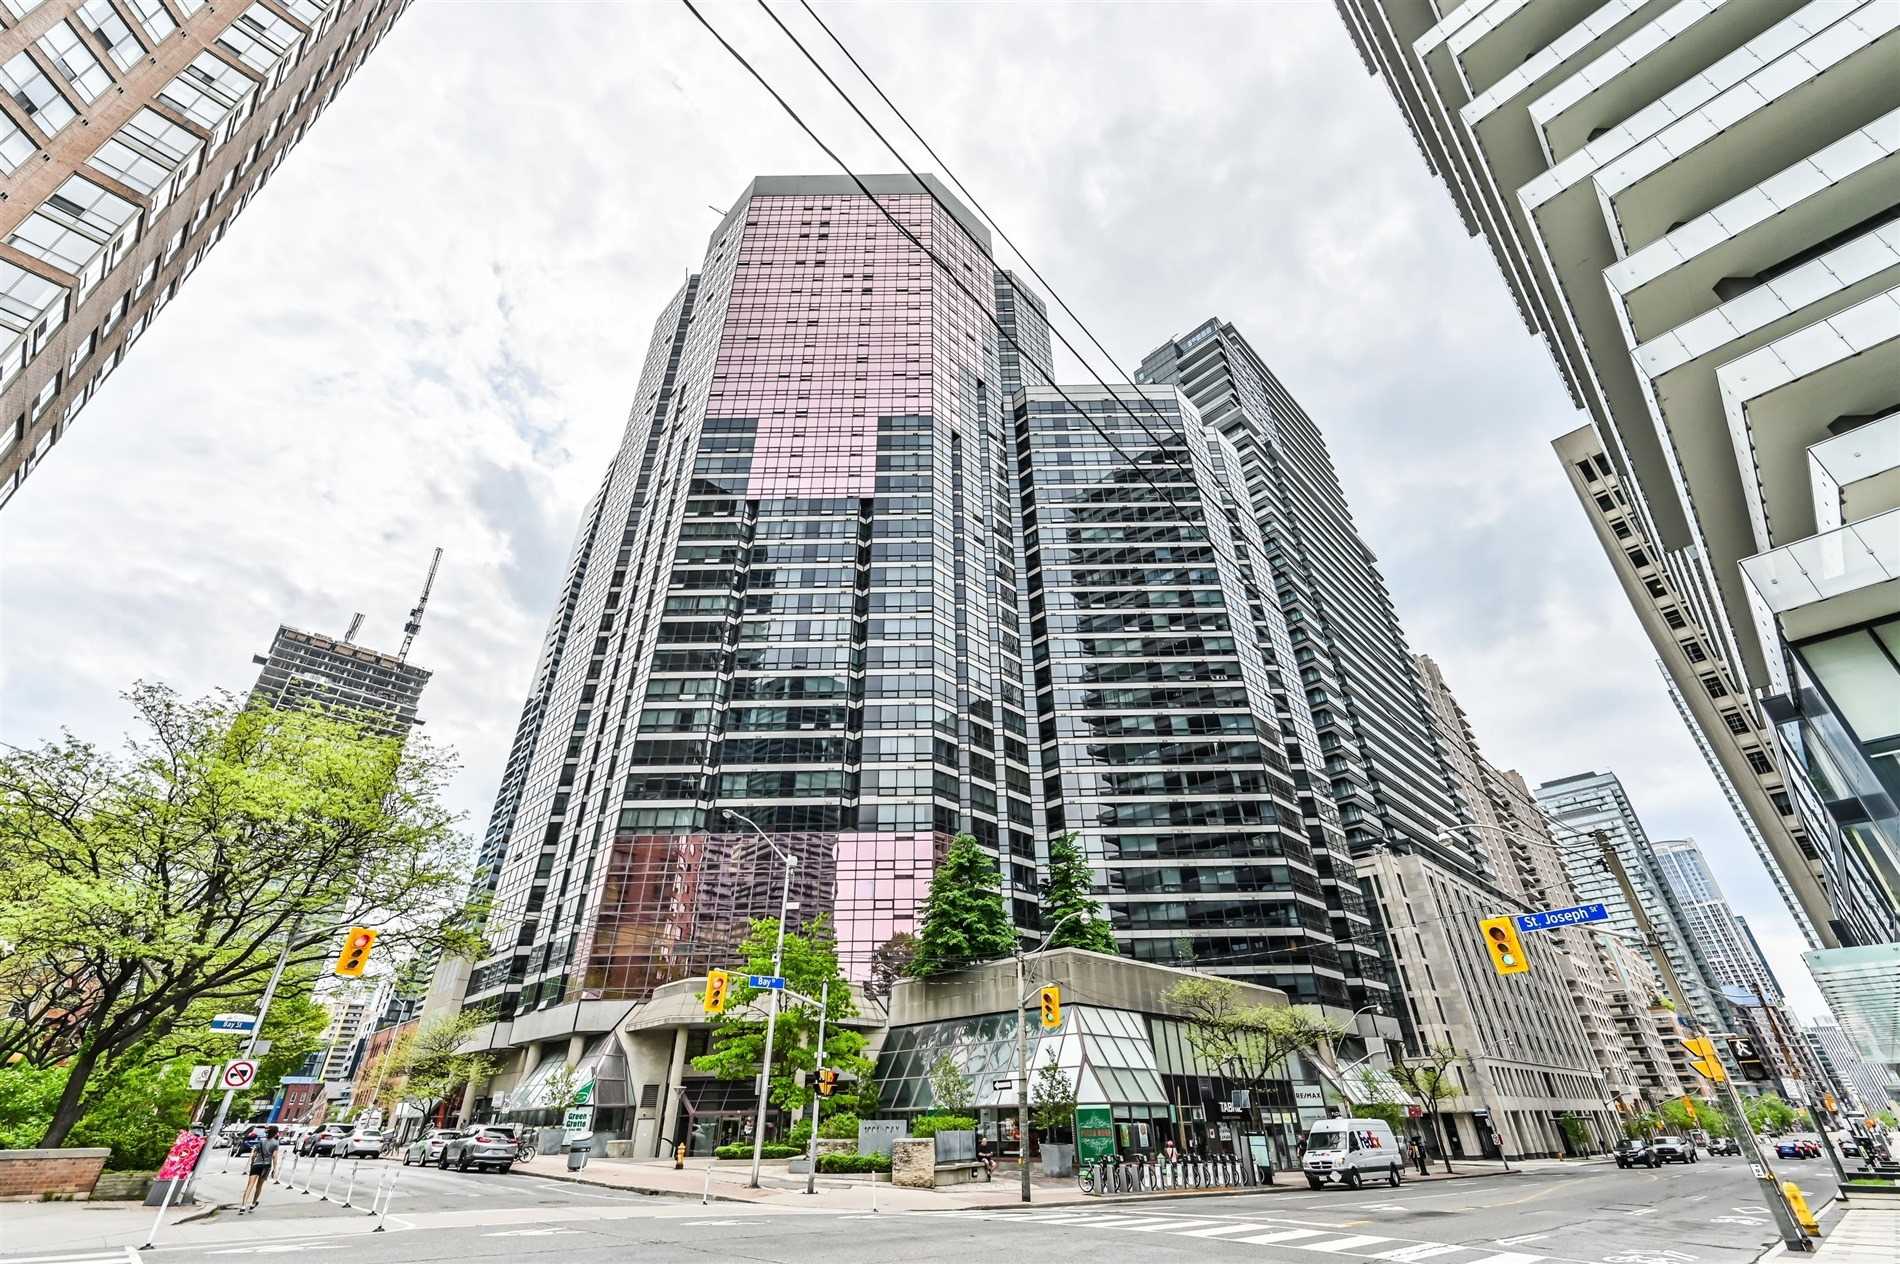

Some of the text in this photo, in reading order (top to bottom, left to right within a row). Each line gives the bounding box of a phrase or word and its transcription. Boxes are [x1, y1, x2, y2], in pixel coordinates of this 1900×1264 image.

[1524, 916, 1542, 928] St.
[1545, 908, 1589, 925] Joseph
[758, 976, 771, 988] Bay
[223, 1020, 235, 1029] Bay
[568, 1112, 587, 1120] Green
[1357, 1130, 1382, 1149] FedEx
